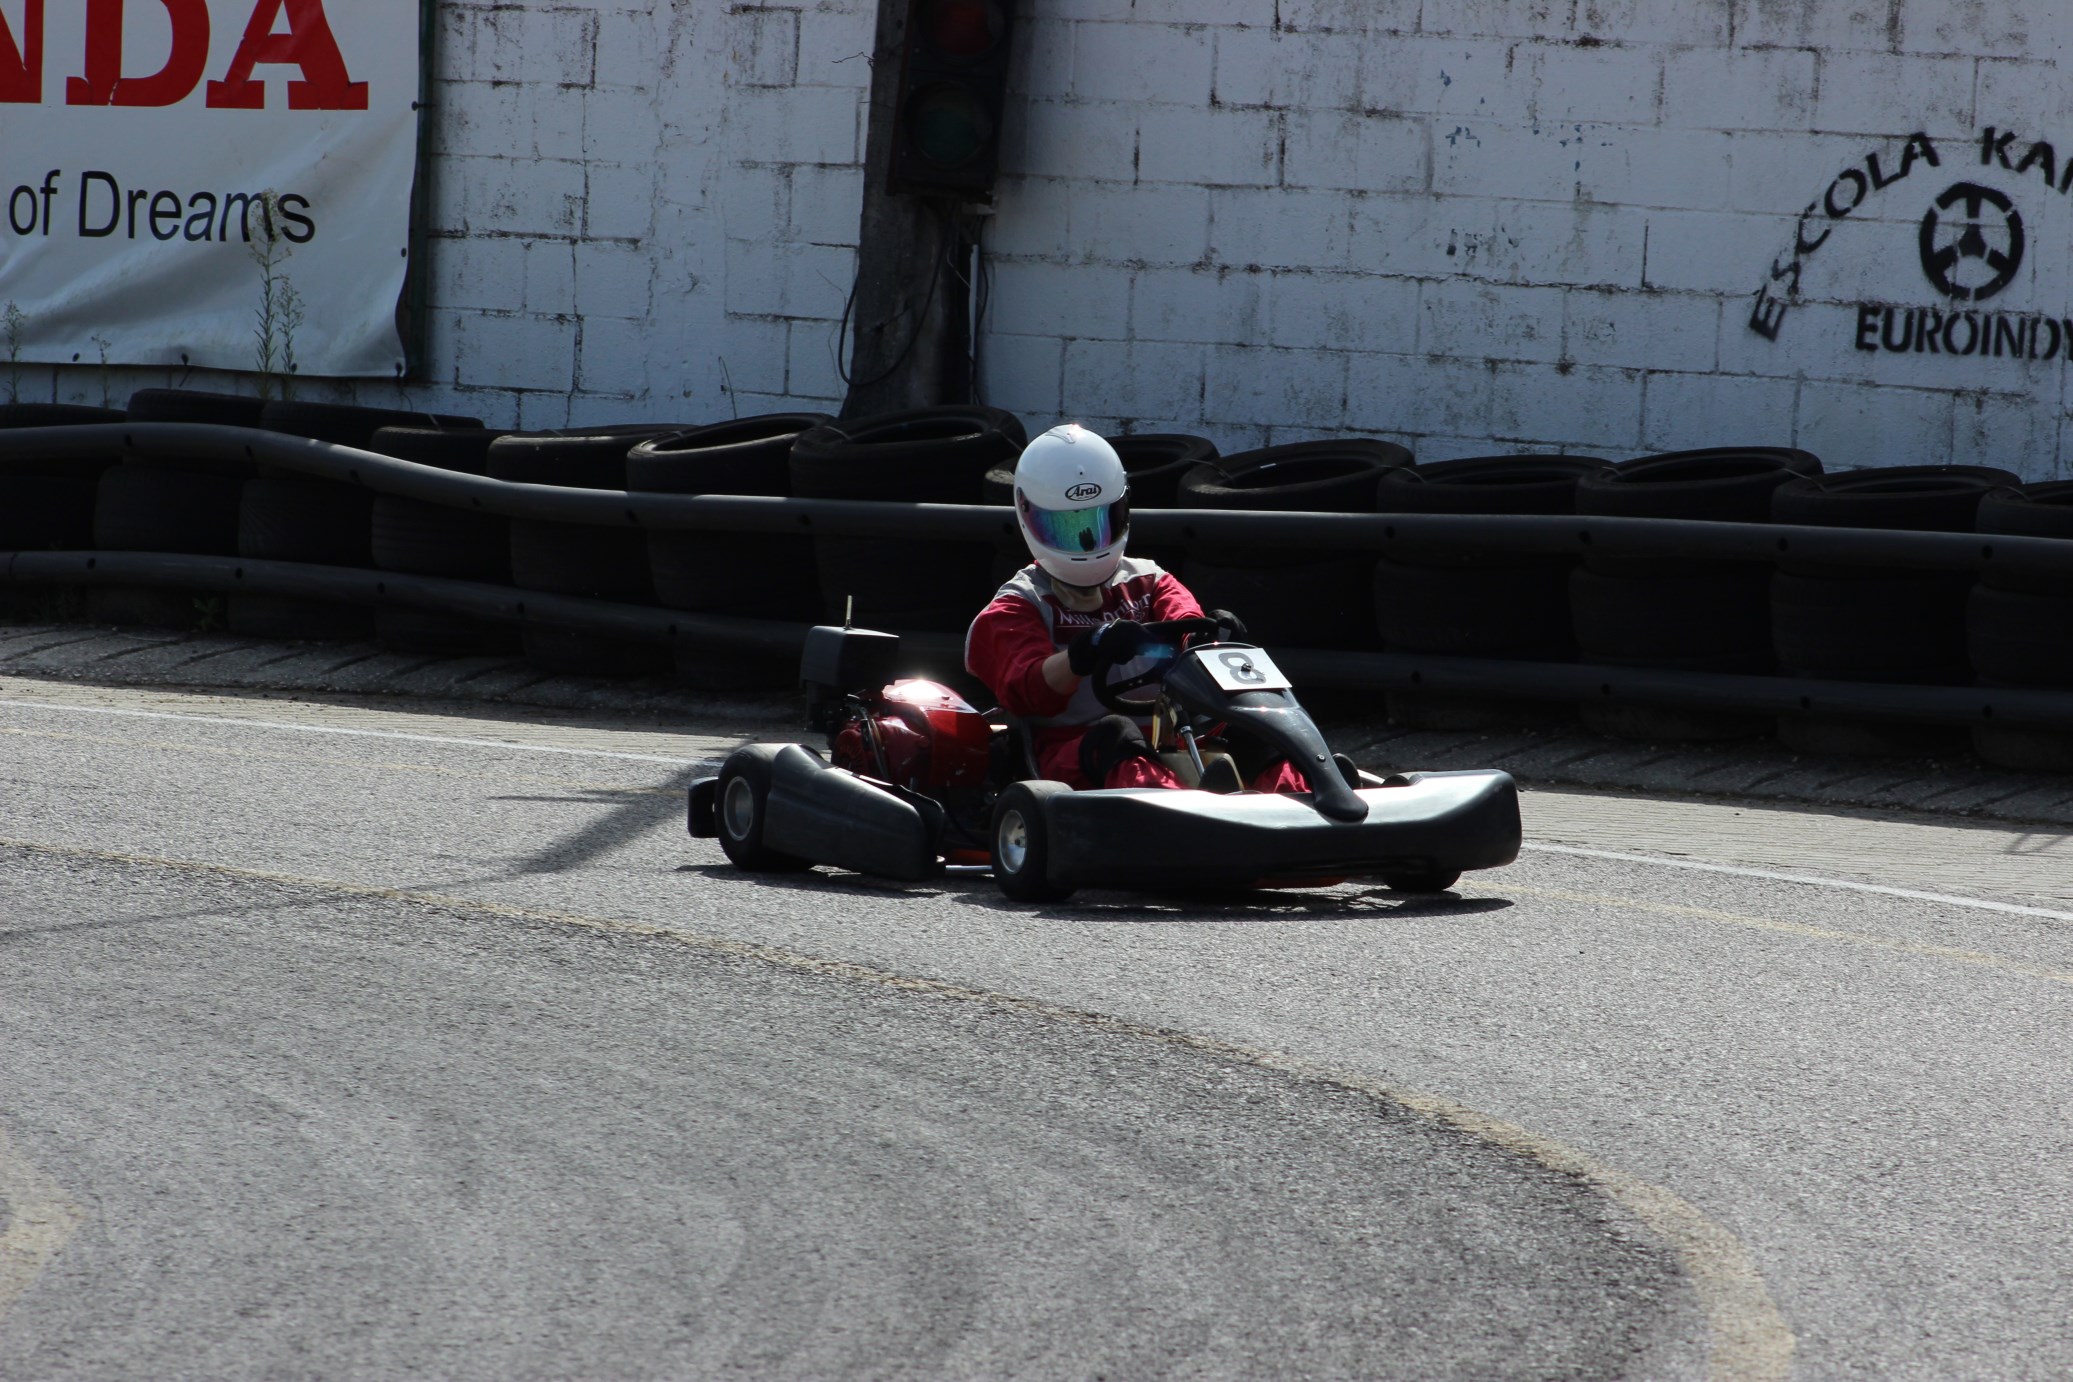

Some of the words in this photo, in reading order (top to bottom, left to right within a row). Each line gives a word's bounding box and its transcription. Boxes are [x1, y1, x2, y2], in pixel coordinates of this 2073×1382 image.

[9, 169, 61, 236] of
[78, 170, 316, 244] Dreams
[1749, 131, 1941, 343] ESCOLA
[1068, 486, 1097, 498] Arai
[1218, 652, 1266, 685] 8
